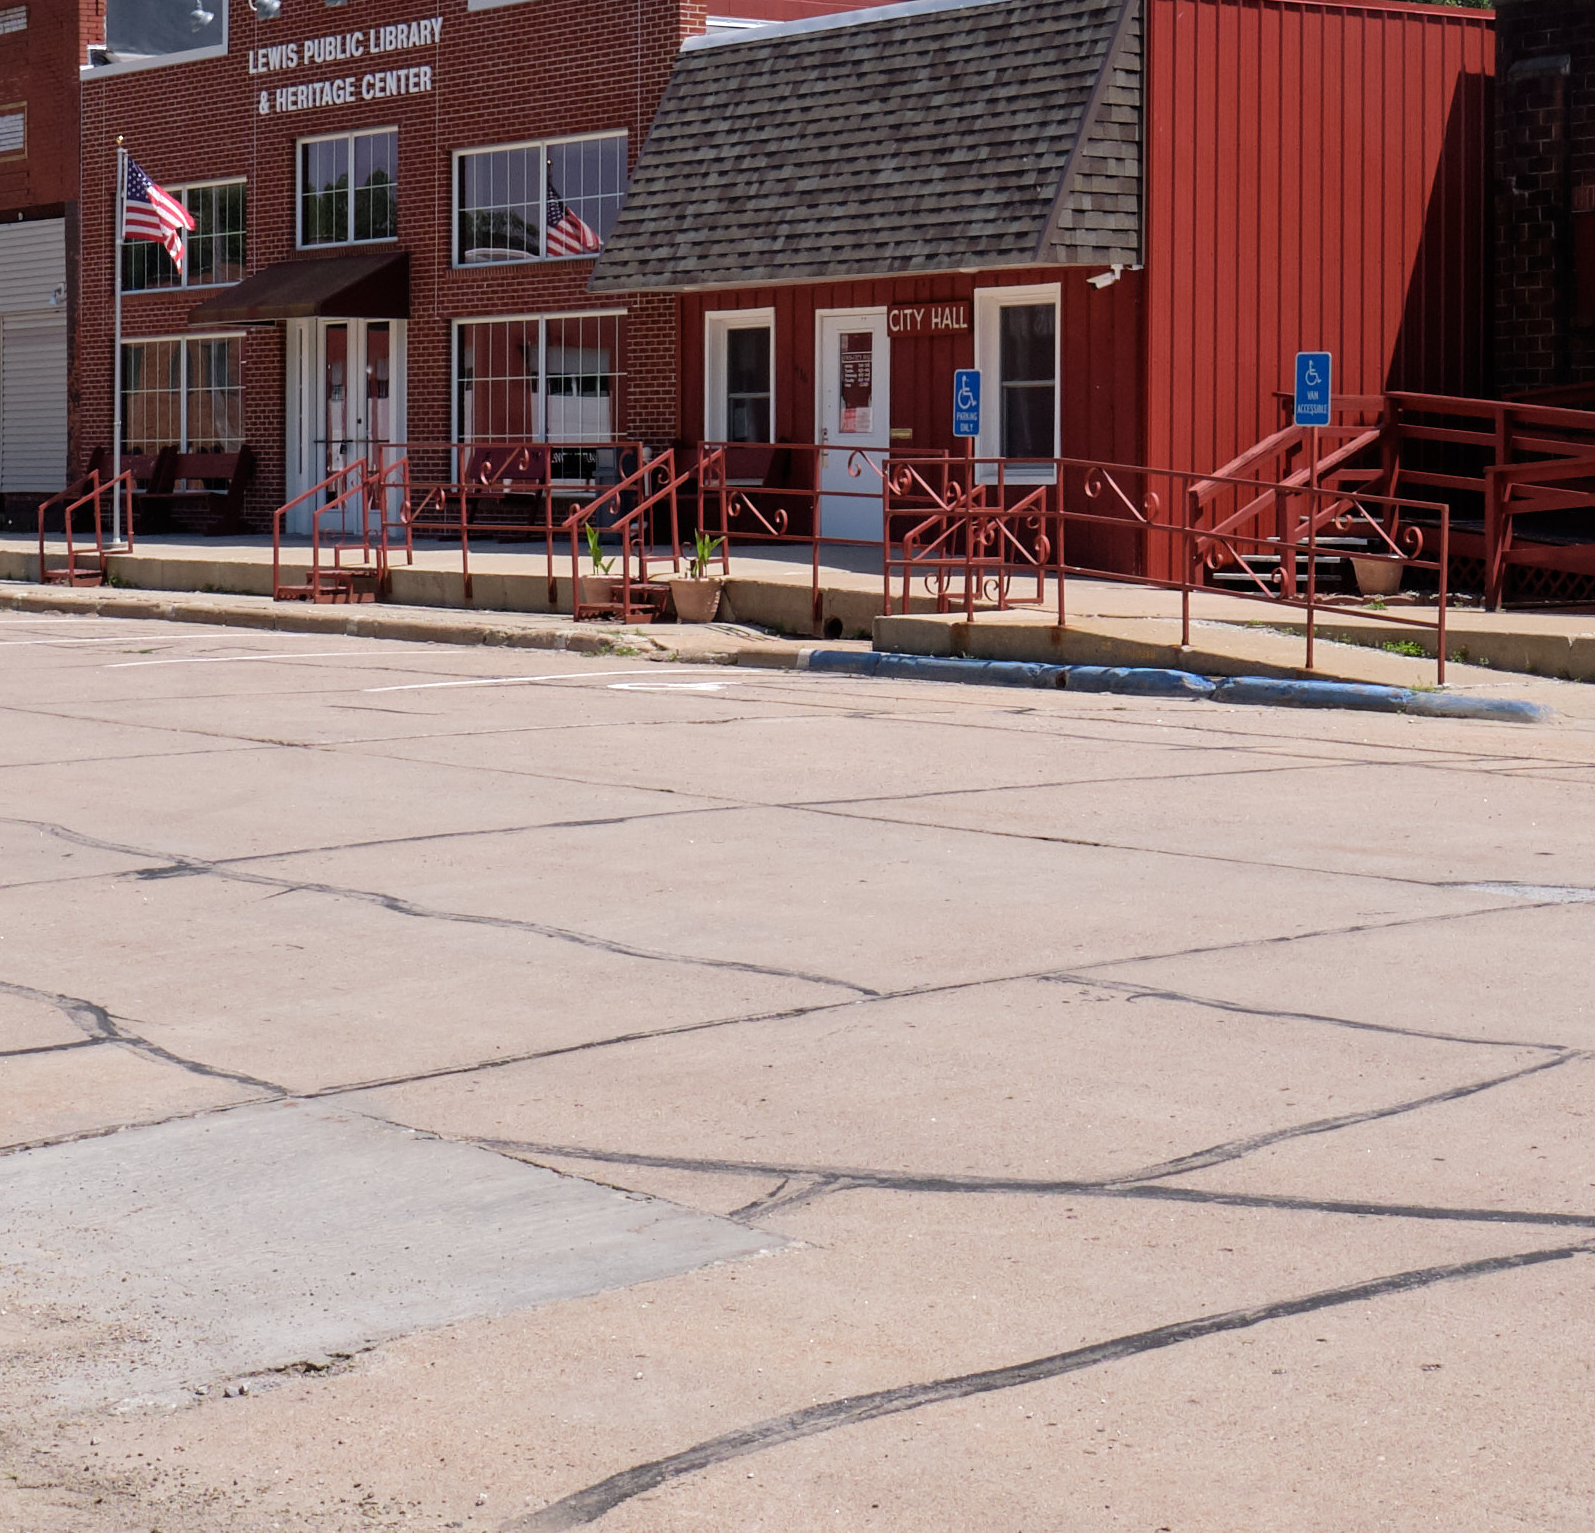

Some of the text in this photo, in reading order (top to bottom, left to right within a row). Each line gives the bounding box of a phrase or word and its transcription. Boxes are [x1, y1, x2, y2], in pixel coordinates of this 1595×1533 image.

[248, 16, 444, 75] LEWIS PUBLIC LIBRARY
[259, 66, 432, 115] & HERITAGE CENTER
[889, 306, 968, 332] CITY HALL
[1307, 391, 1318, 400] VAN
[1297, 403, 1328, 415] ACCESSIBLE
[956, 412, 977, 421] PARKING
[960, 423, 974, 432] ONLY
